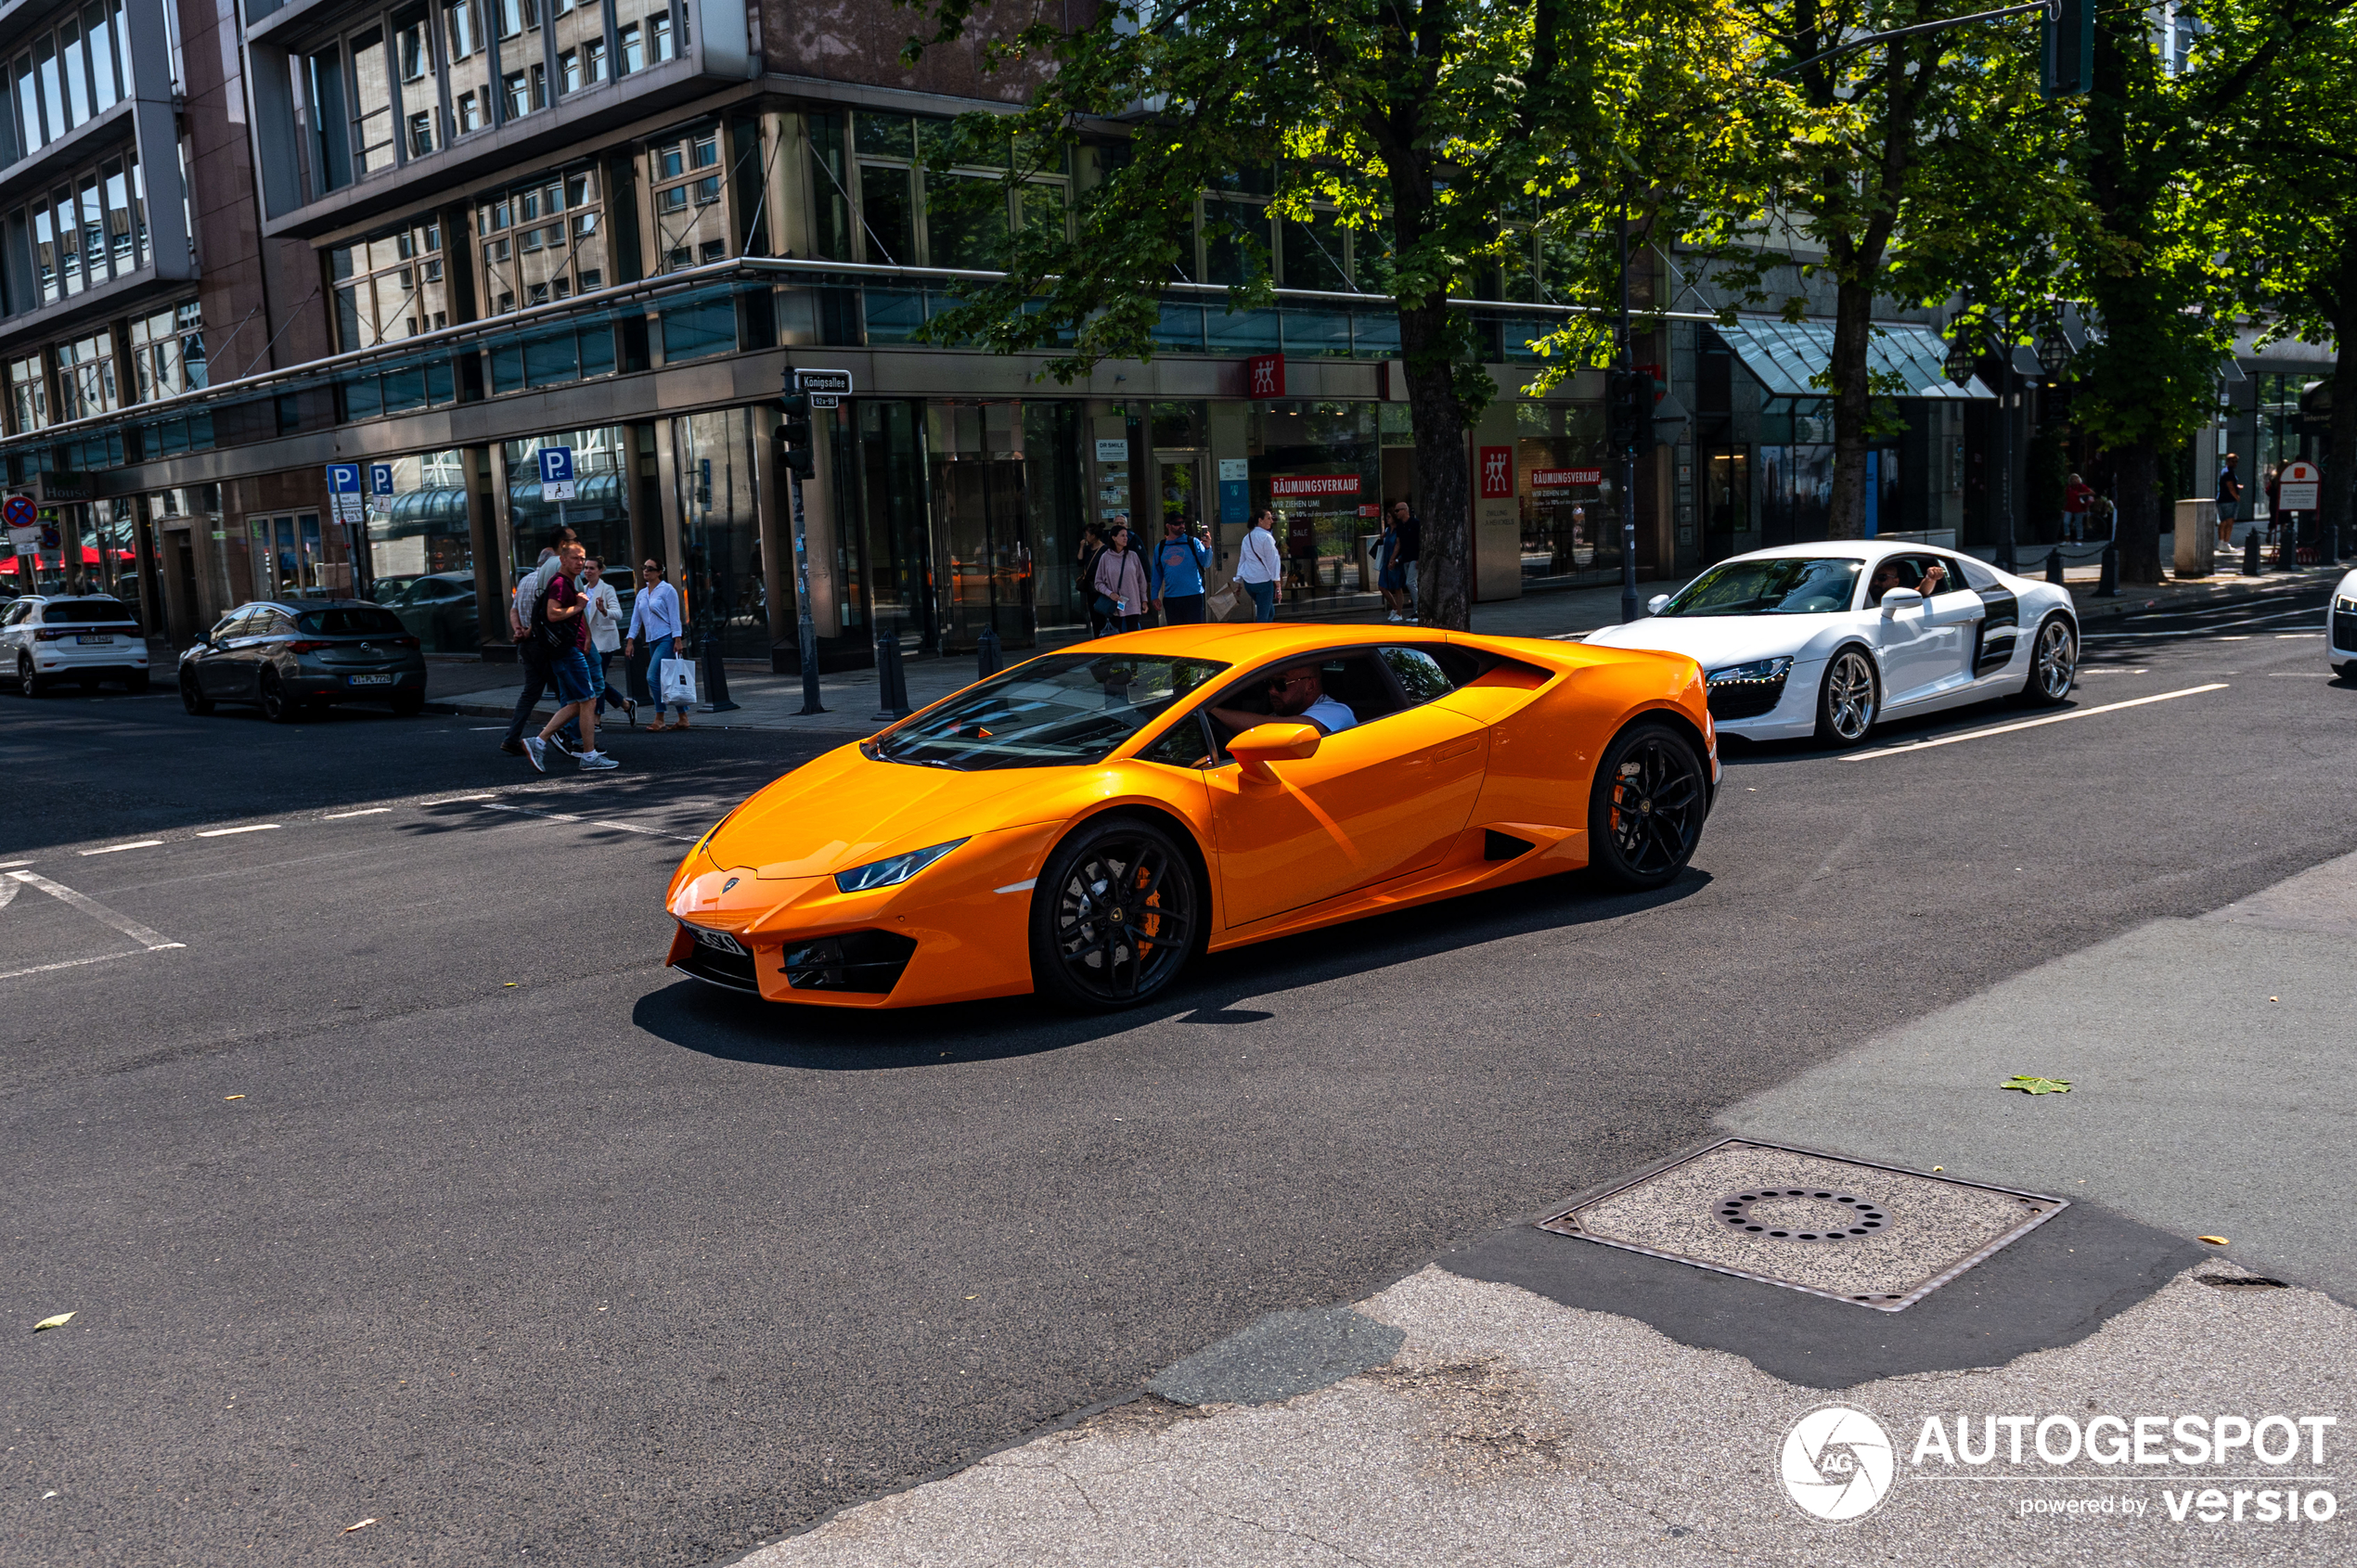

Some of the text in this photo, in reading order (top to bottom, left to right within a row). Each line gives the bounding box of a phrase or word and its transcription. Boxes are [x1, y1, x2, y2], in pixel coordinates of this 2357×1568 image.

[804, 376, 845, 390] Königsallee
[815, 397, 834, 405] 92a-98
[1168, 418, 1191, 431] 92A
[546, 452, 564, 479] P
[334, 469, 352, 492] P
[374, 469, 388, 492] P
[1533, 470, 1600, 484] RÄUMUNGSVERKAUF
[45, 487, 90, 498] House
[1273, 478, 1359, 494] RÄUMUNGSVERKAUF
